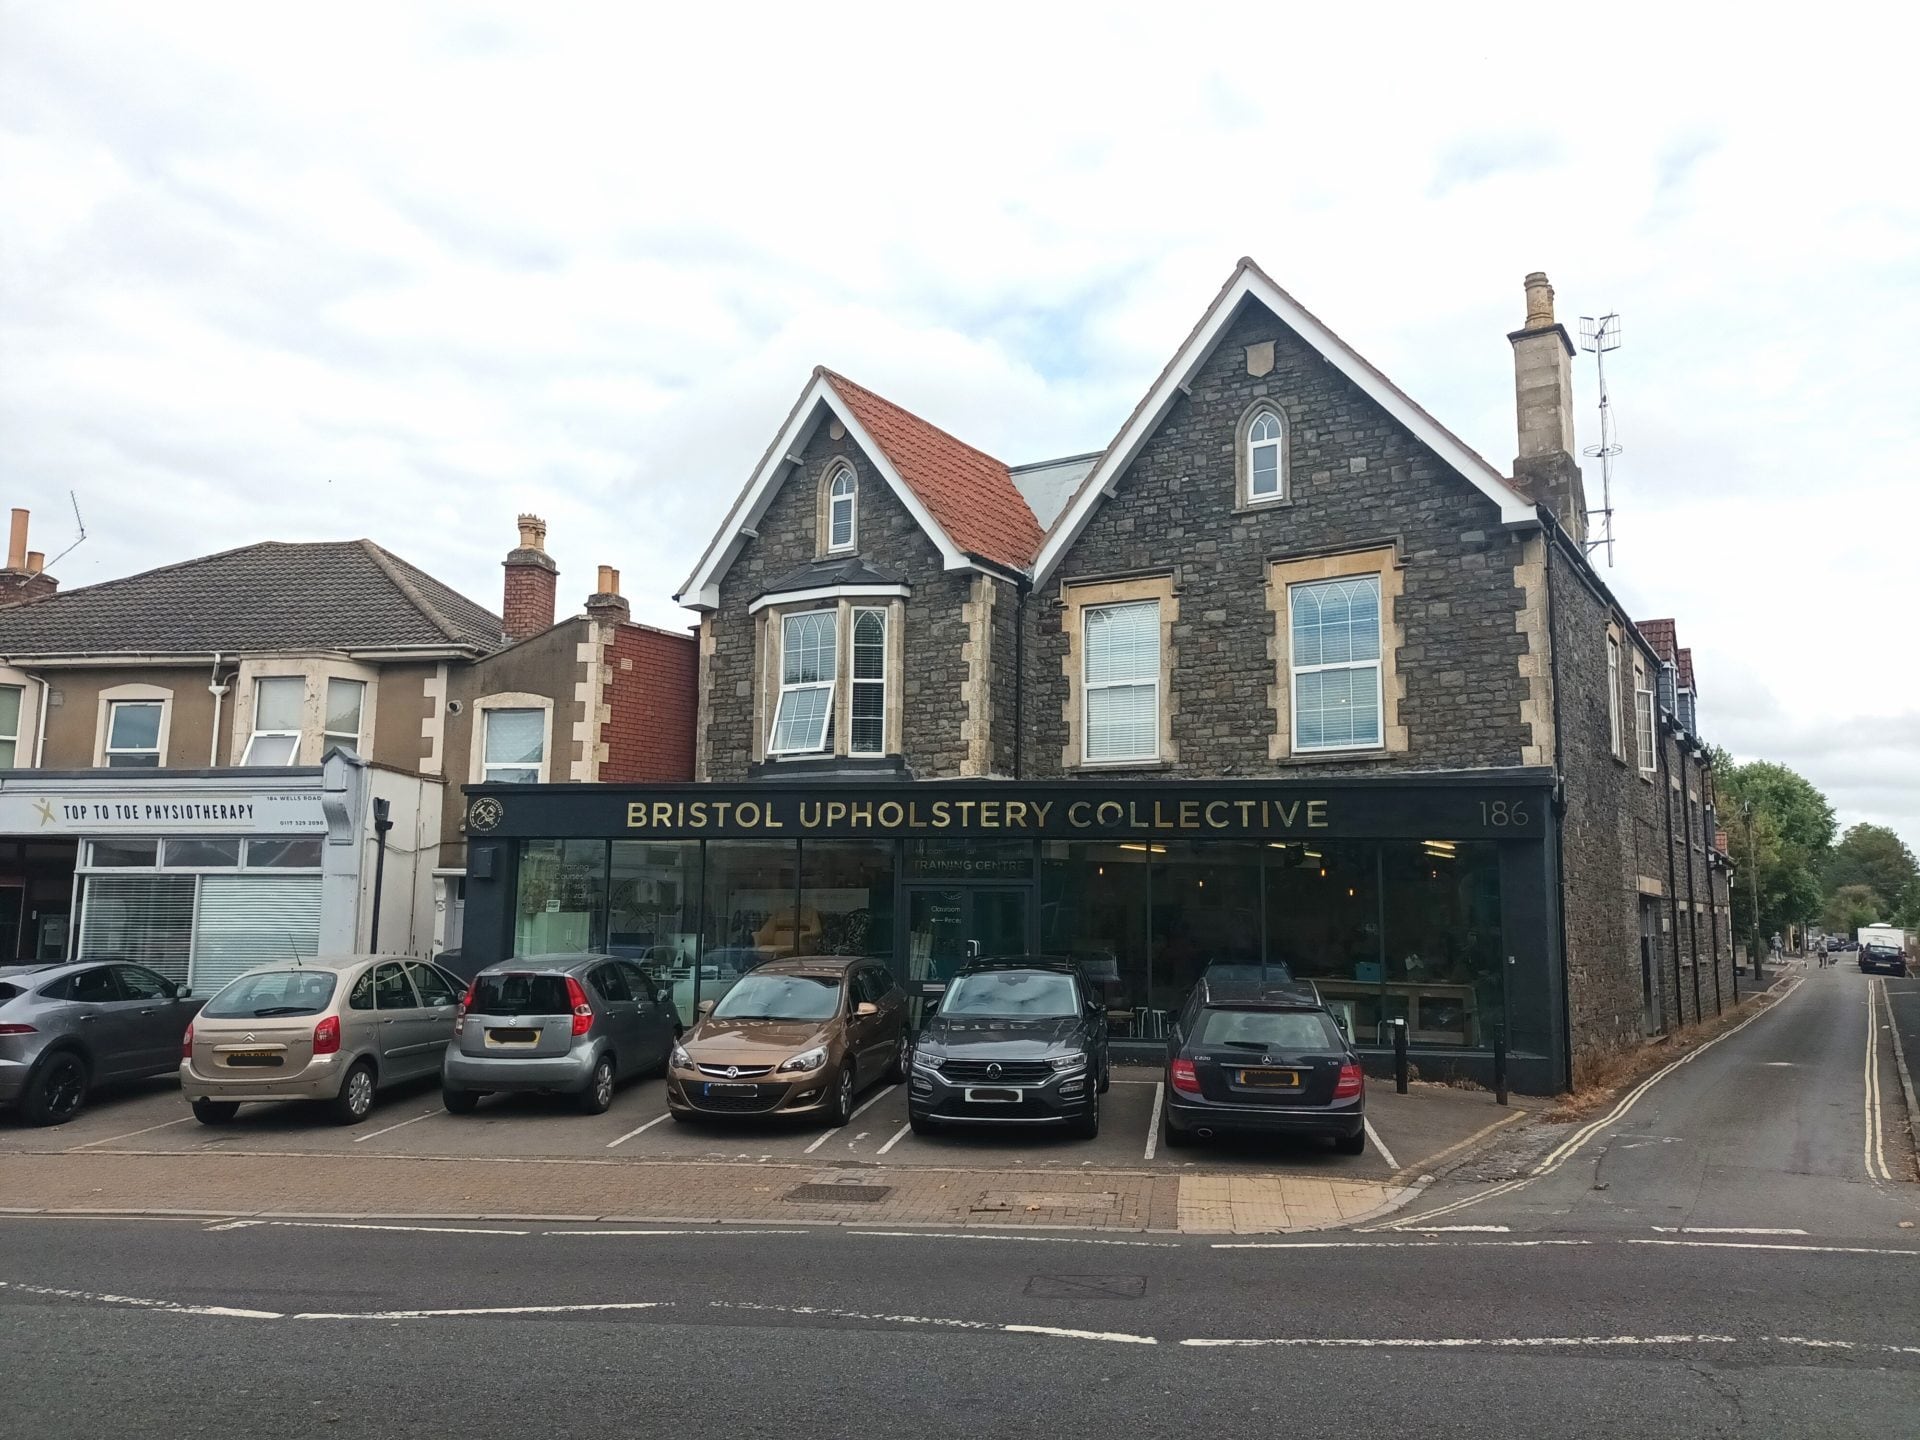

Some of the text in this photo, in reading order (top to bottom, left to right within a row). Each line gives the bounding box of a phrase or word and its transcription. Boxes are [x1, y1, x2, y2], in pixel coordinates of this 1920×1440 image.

[64, 804, 254, 820] TOP TO TOE PHYSIOTHERAPY
[626, 800, 1329, 828] BRISTOL UPHOLSTERY COLLECTIVE
[1480, 800, 1529, 826] 186
[912, 860, 1025, 871] TRAINING CENTRE
